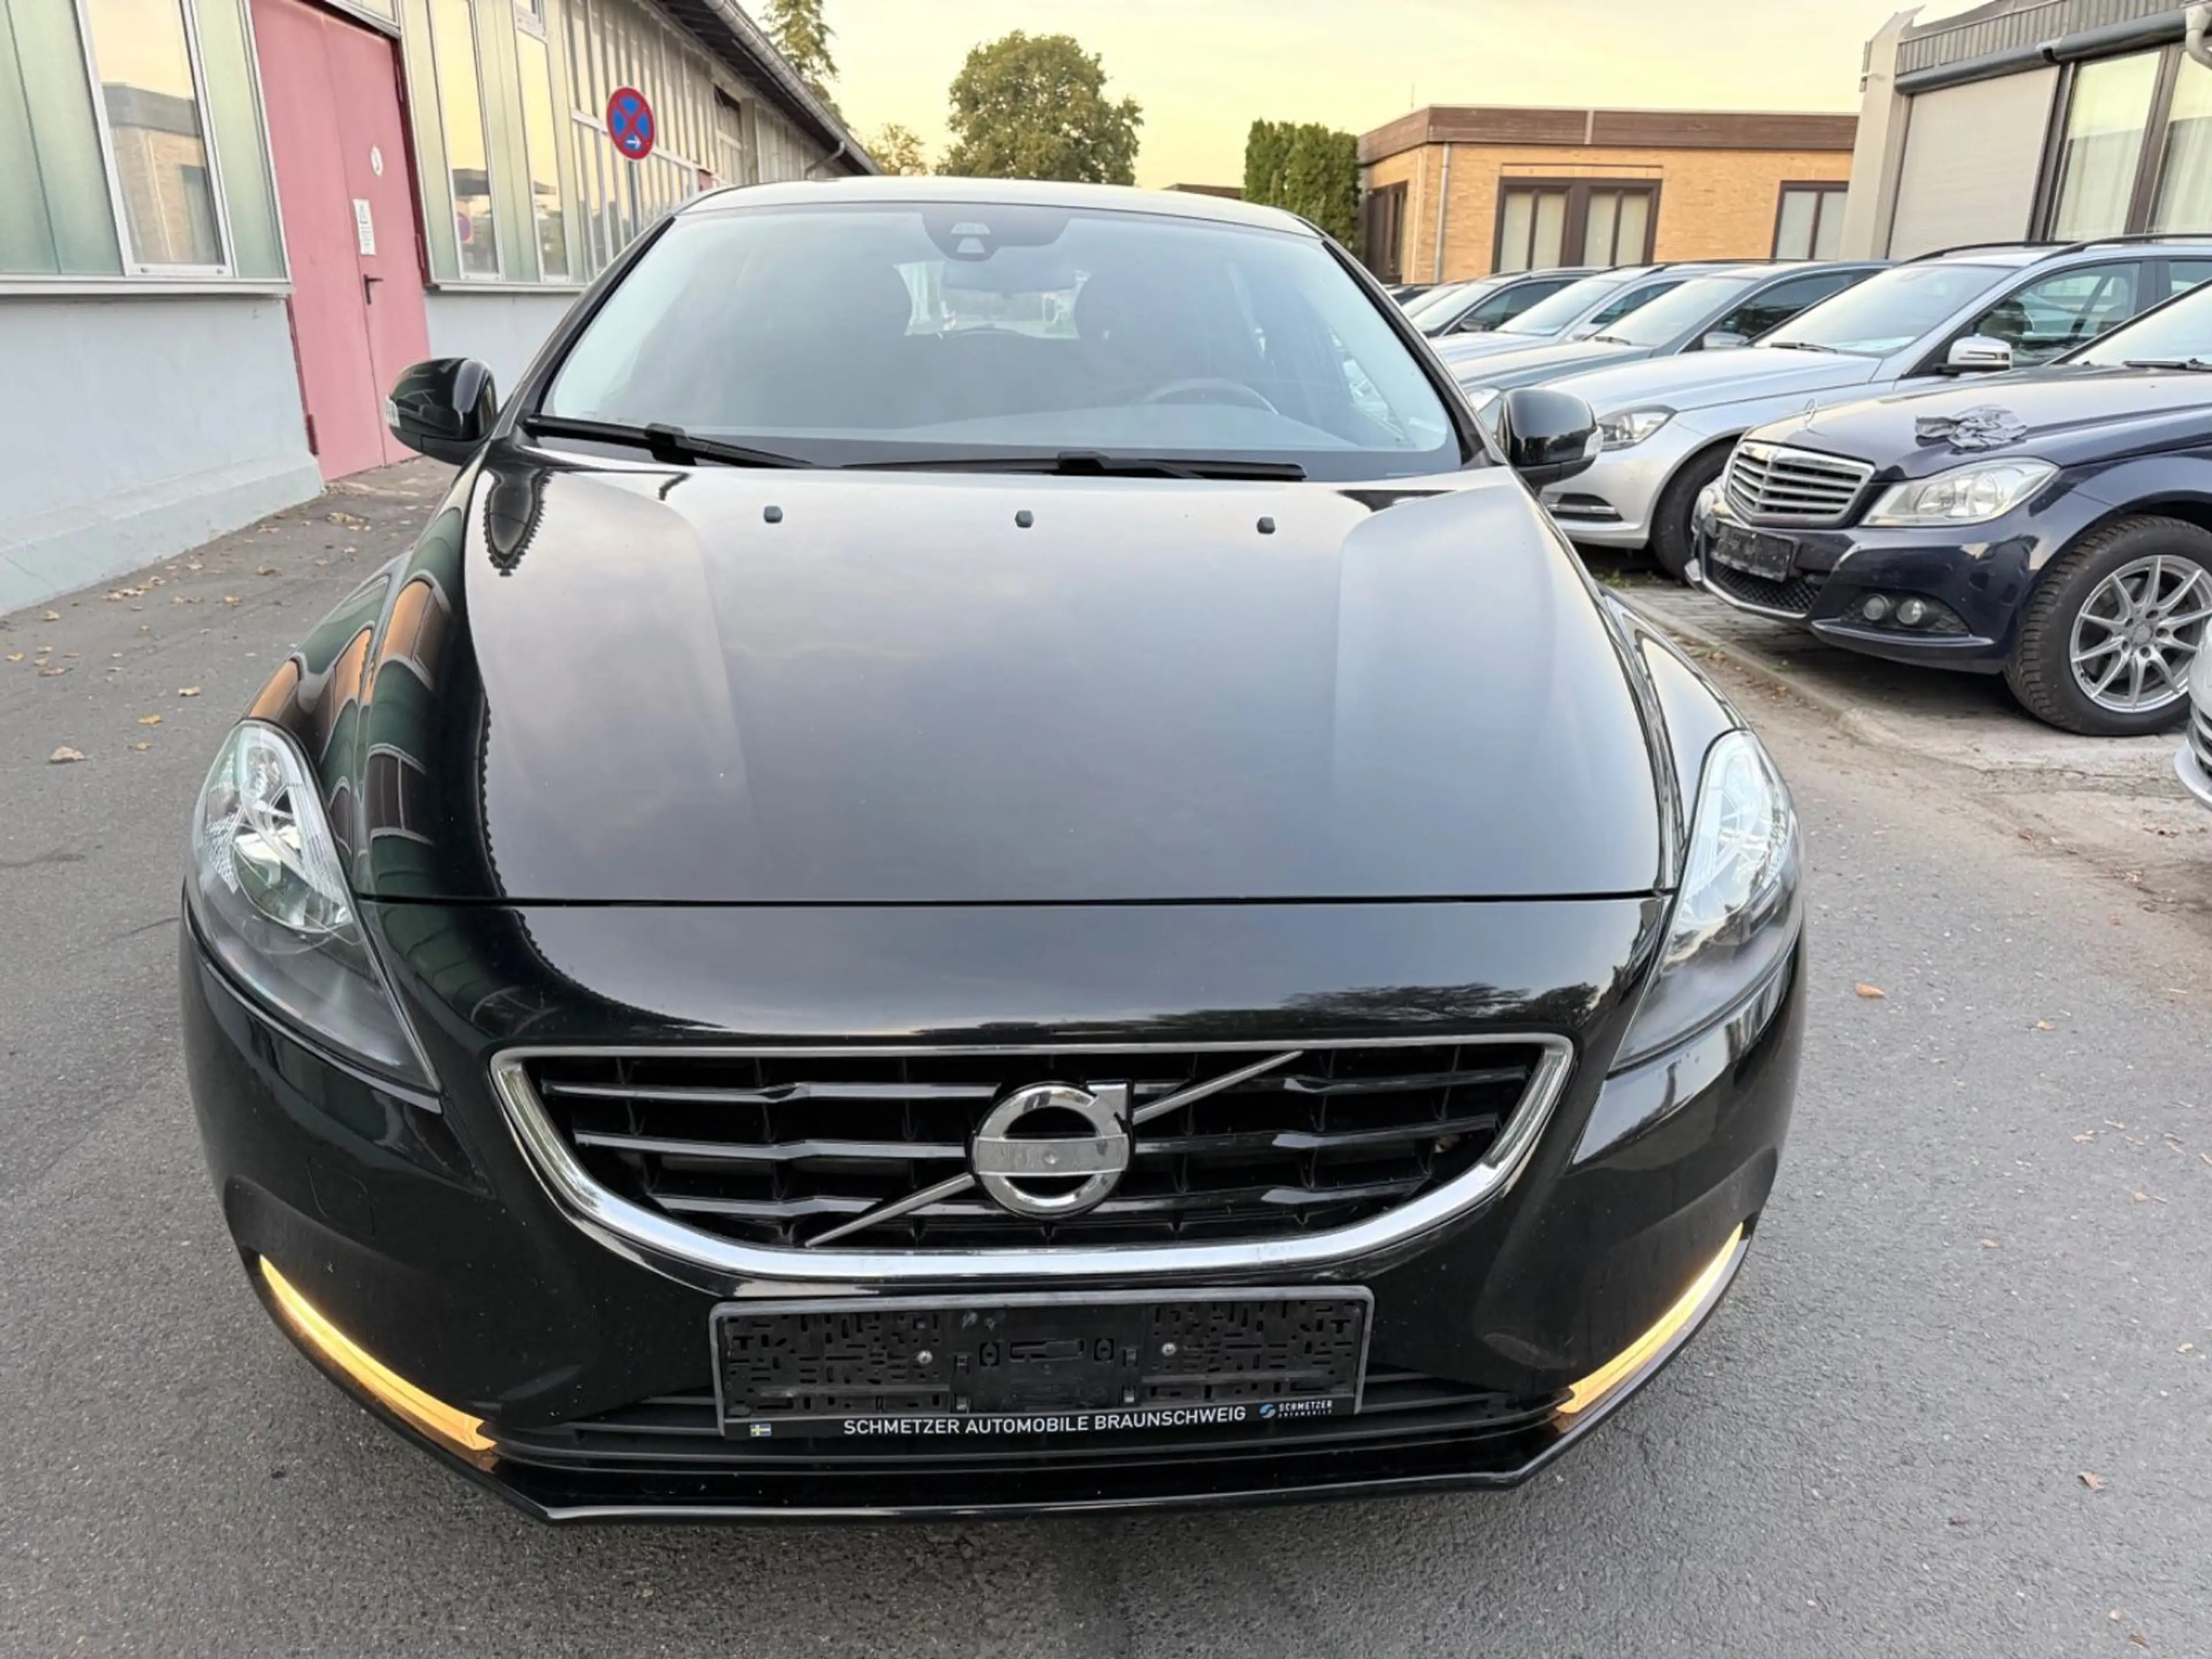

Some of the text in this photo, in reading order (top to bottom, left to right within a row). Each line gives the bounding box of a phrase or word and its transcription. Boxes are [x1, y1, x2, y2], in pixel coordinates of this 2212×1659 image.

[843, 1406, 1247, 1435] SCHMETZER AUTOMOBILE BRAUNSCHWEIG
